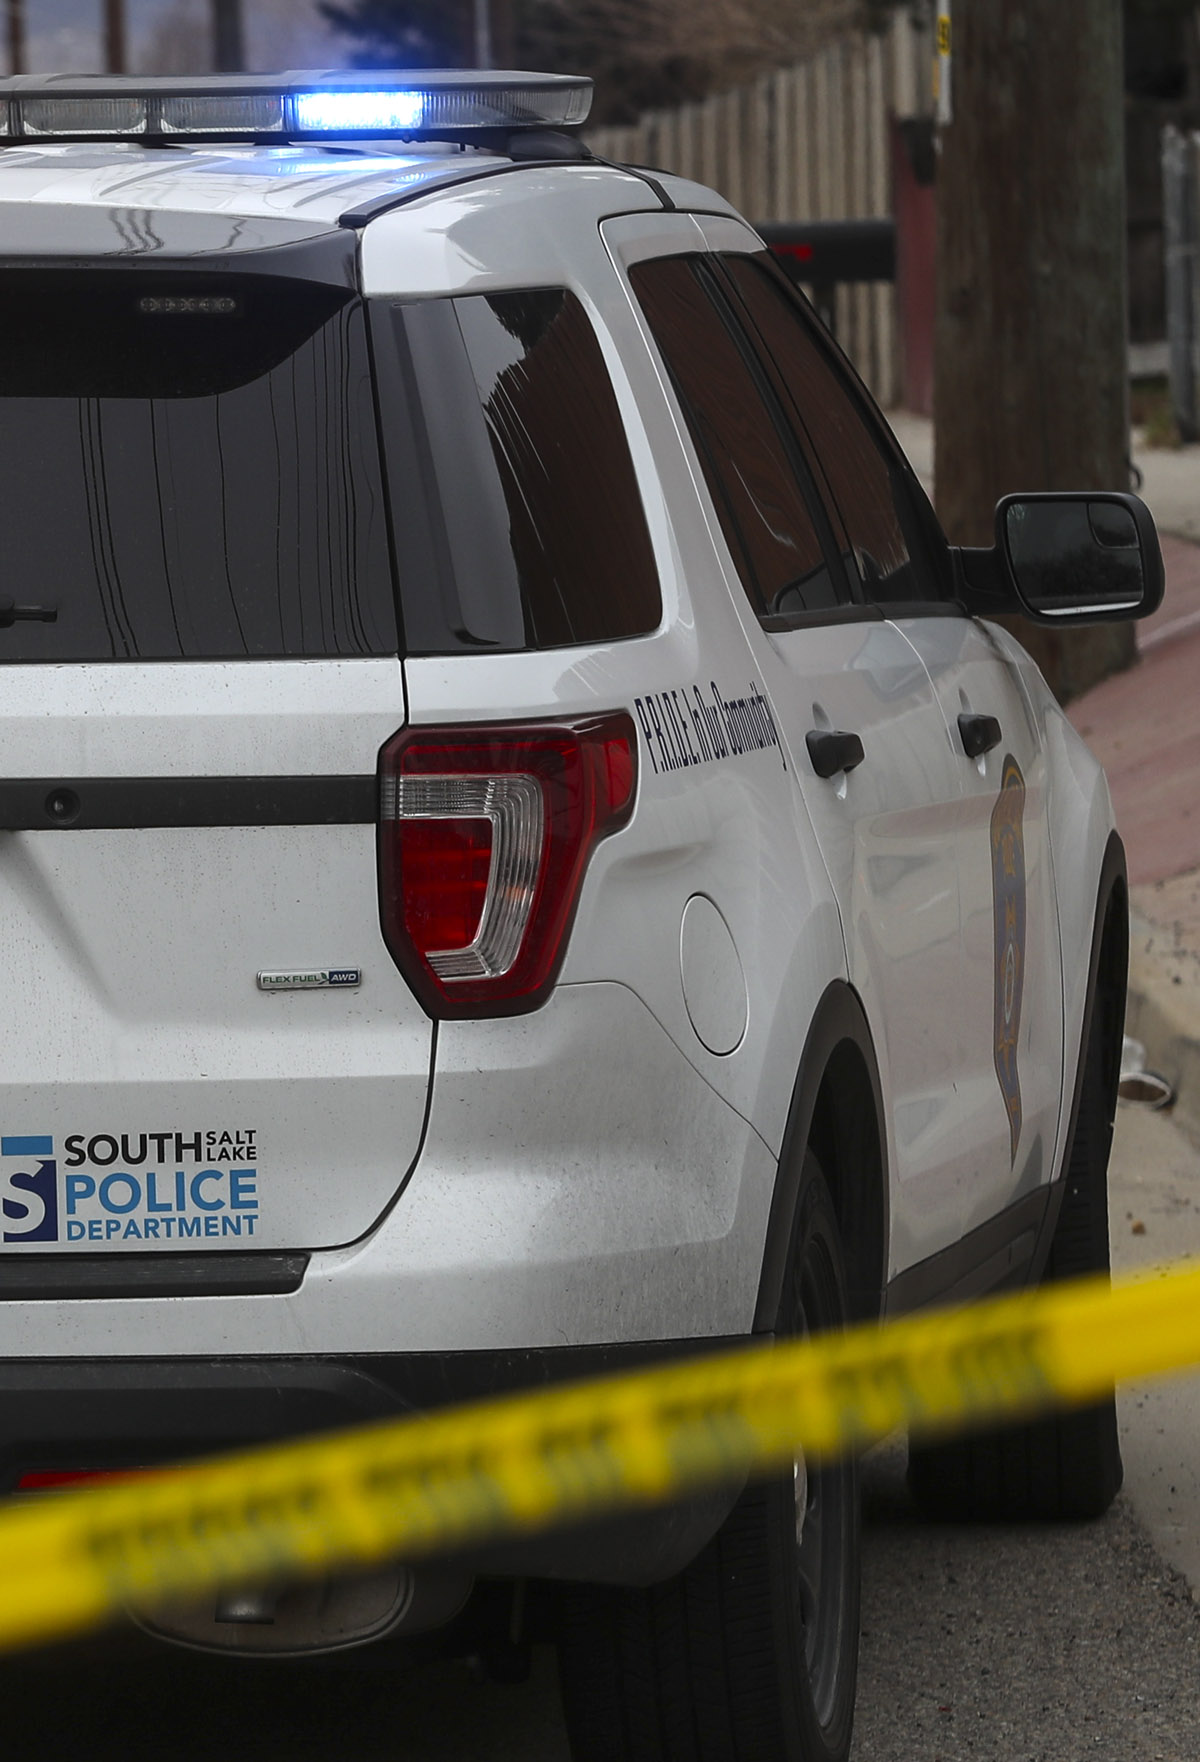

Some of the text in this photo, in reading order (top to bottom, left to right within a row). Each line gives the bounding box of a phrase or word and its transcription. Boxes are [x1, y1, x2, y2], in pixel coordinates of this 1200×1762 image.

[262, 973, 357, 984] FLEX FUEL AWD
[205, 1129, 257, 1146] SALT
[64, 1132, 203, 1167] SOUTH
[206, 1146, 257, 1161] LAKE
[66, 1168, 259, 1215] POLICE
[66, 1215, 259, 1241] DEPARTMENT
